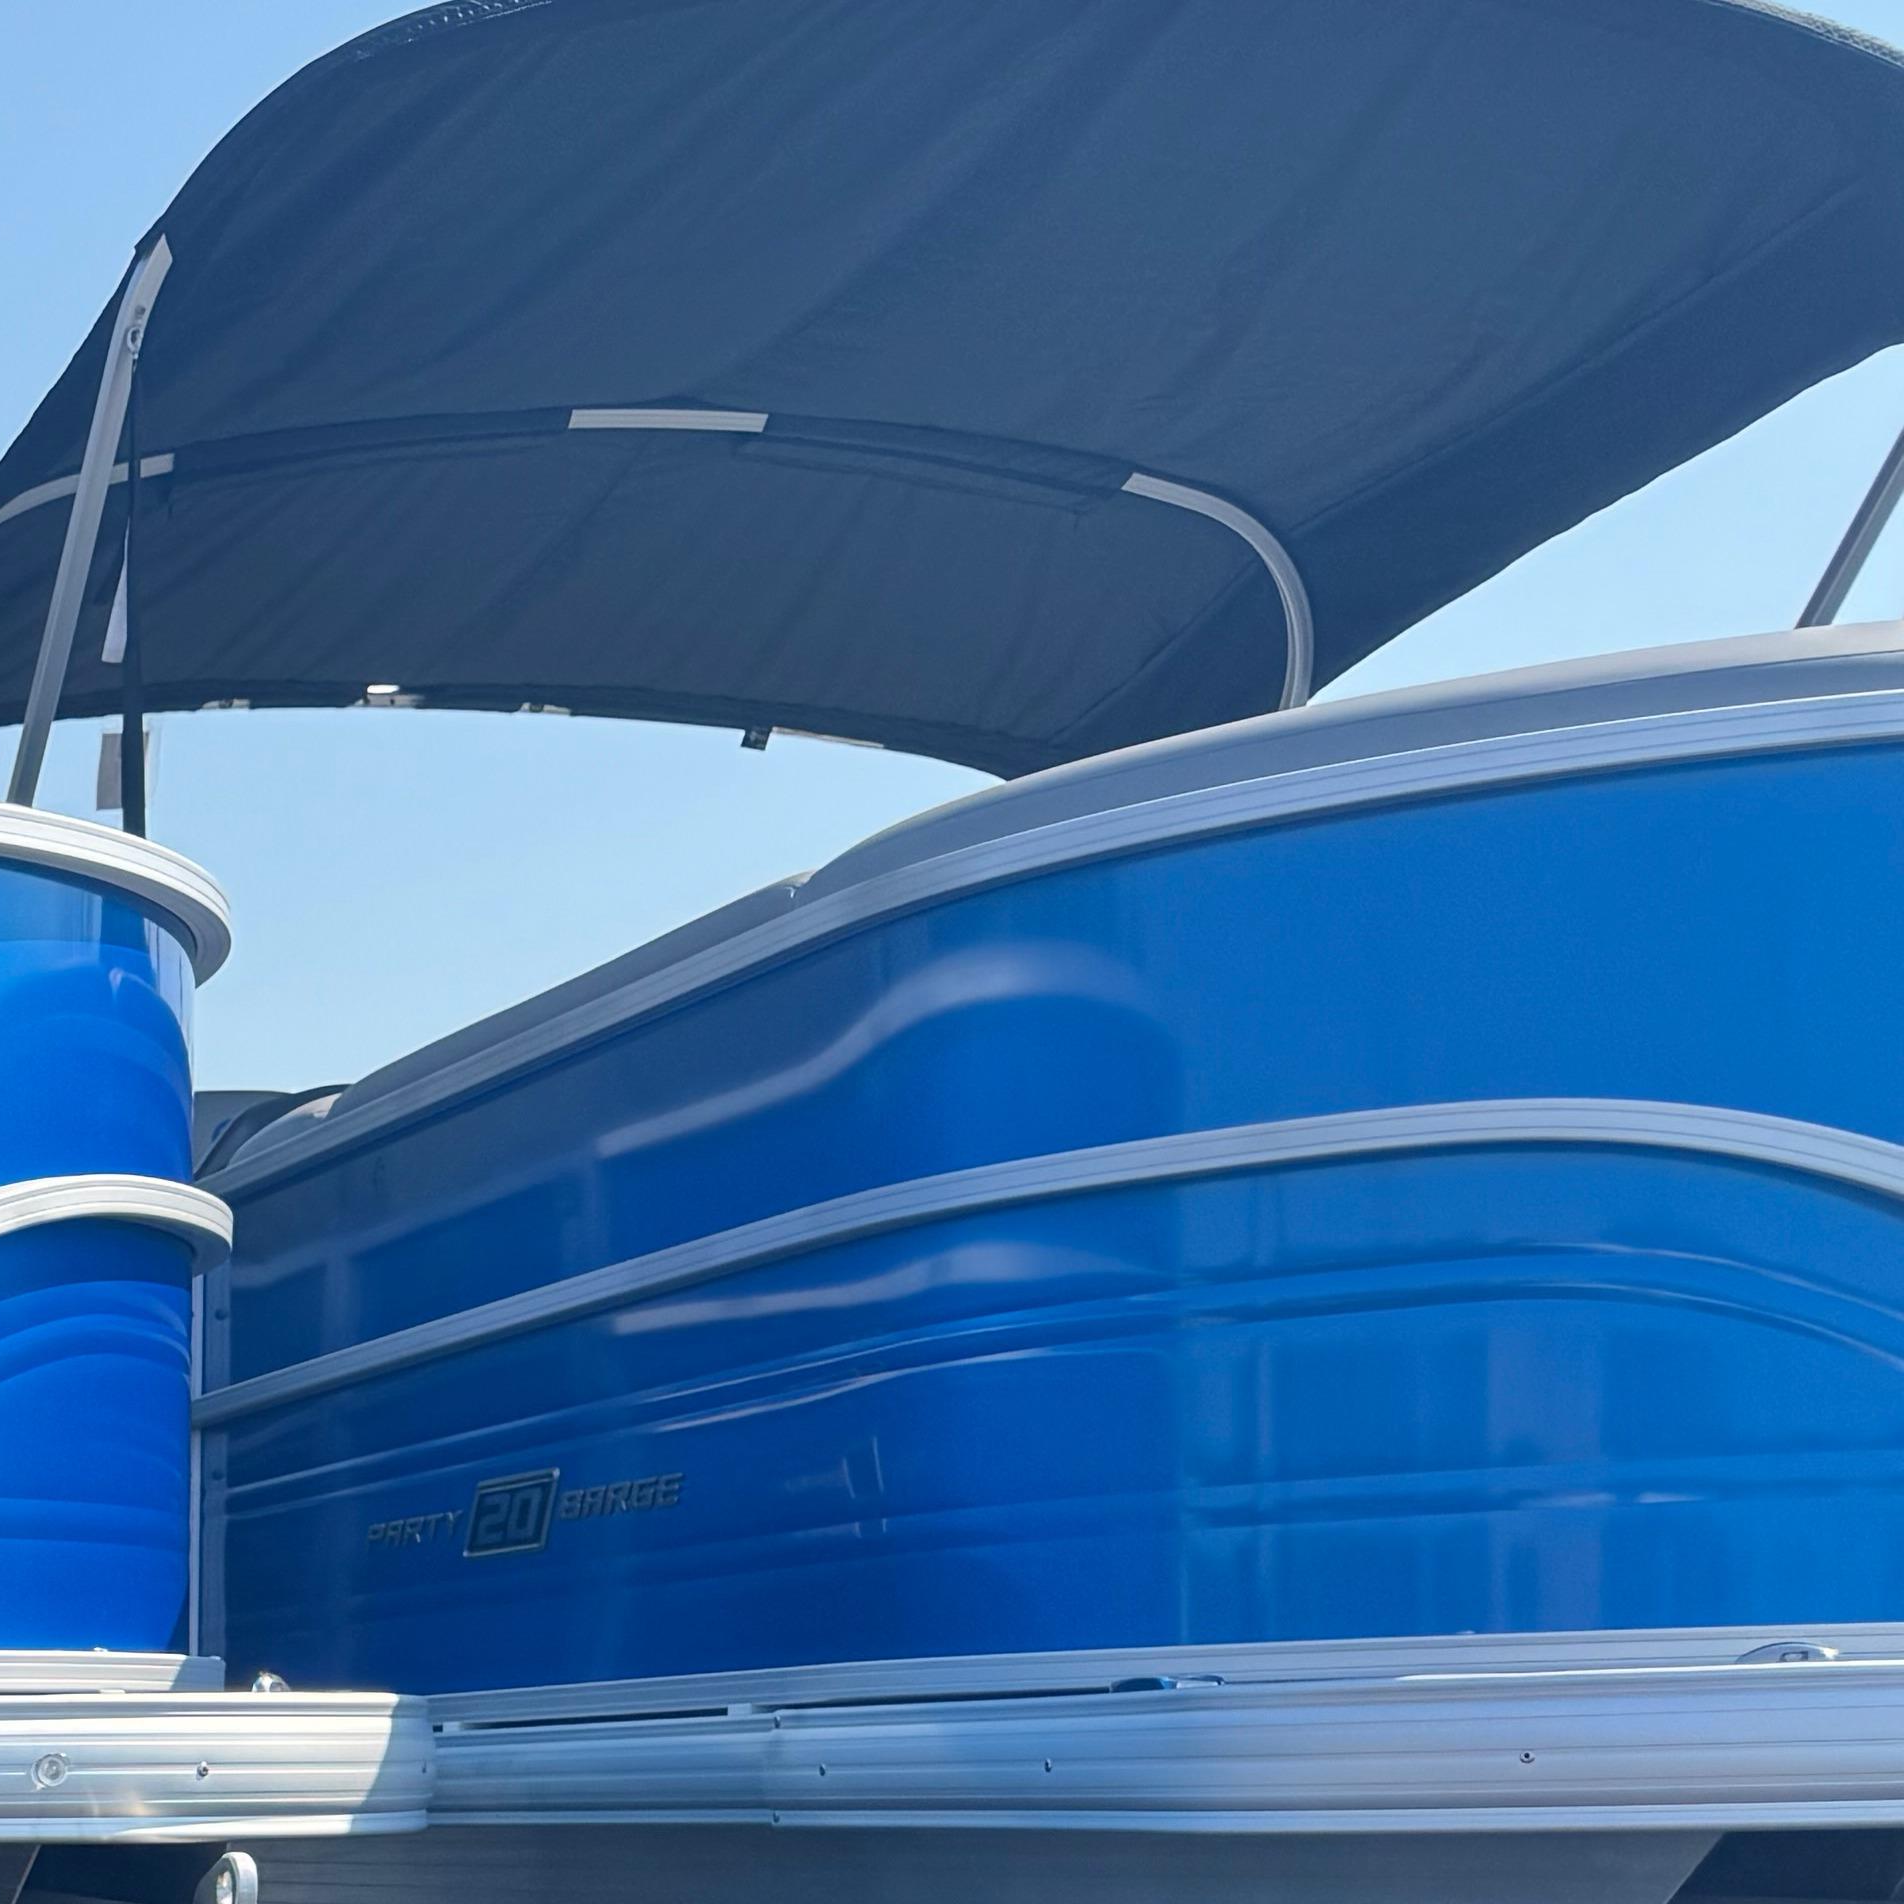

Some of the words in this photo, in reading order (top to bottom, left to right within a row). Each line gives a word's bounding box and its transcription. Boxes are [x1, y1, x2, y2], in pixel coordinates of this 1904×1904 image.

[367, 1510, 462, 1548] PARTY
[477, 1487, 545, 1543] 20
[559, 1473, 684, 1520] BARGE
